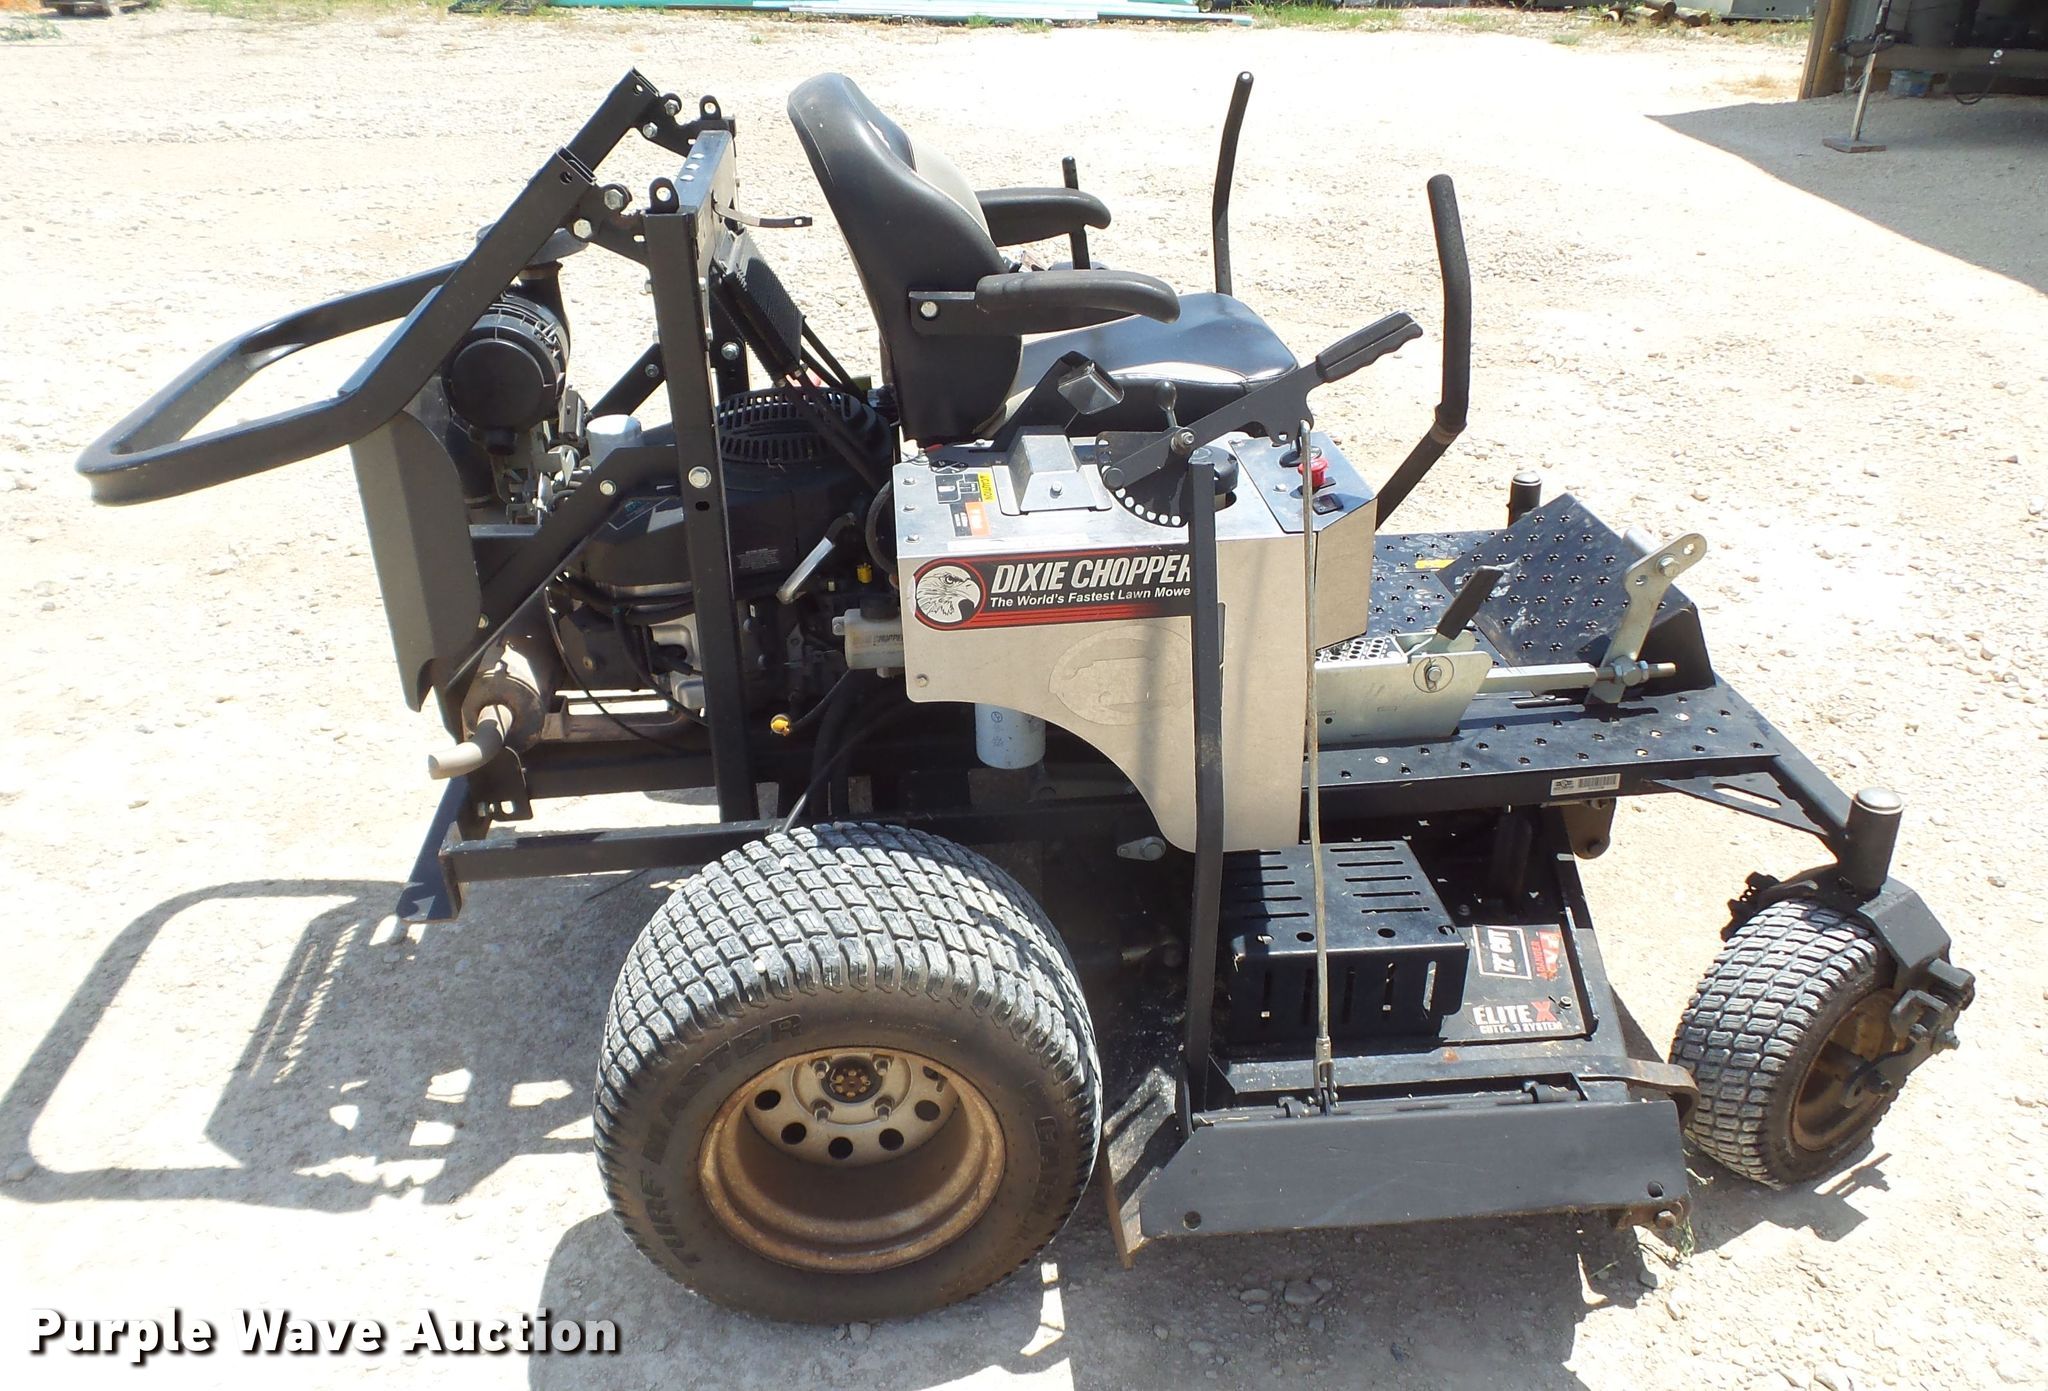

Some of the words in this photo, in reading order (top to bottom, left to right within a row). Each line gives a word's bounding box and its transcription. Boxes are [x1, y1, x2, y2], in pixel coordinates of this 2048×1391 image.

[982, 478, 993, 501] CAUTION
[991, 561, 1069, 593] DIXIE
[990, 597, 1013, 608] The
[1017, 592, 1065, 607] World's
[1068, 590, 1115, 604] Fastest
[1118, 588, 1151, 600] Lawn
[1154, 586, 1191, 598] Mowe
[1487, 929, 1513, 954] CUT
[1472, 1004, 1533, 1025] ELITE
[1531, 1000, 1558, 1022] X
[1522, 1020, 1563, 1033] SYSTEM
